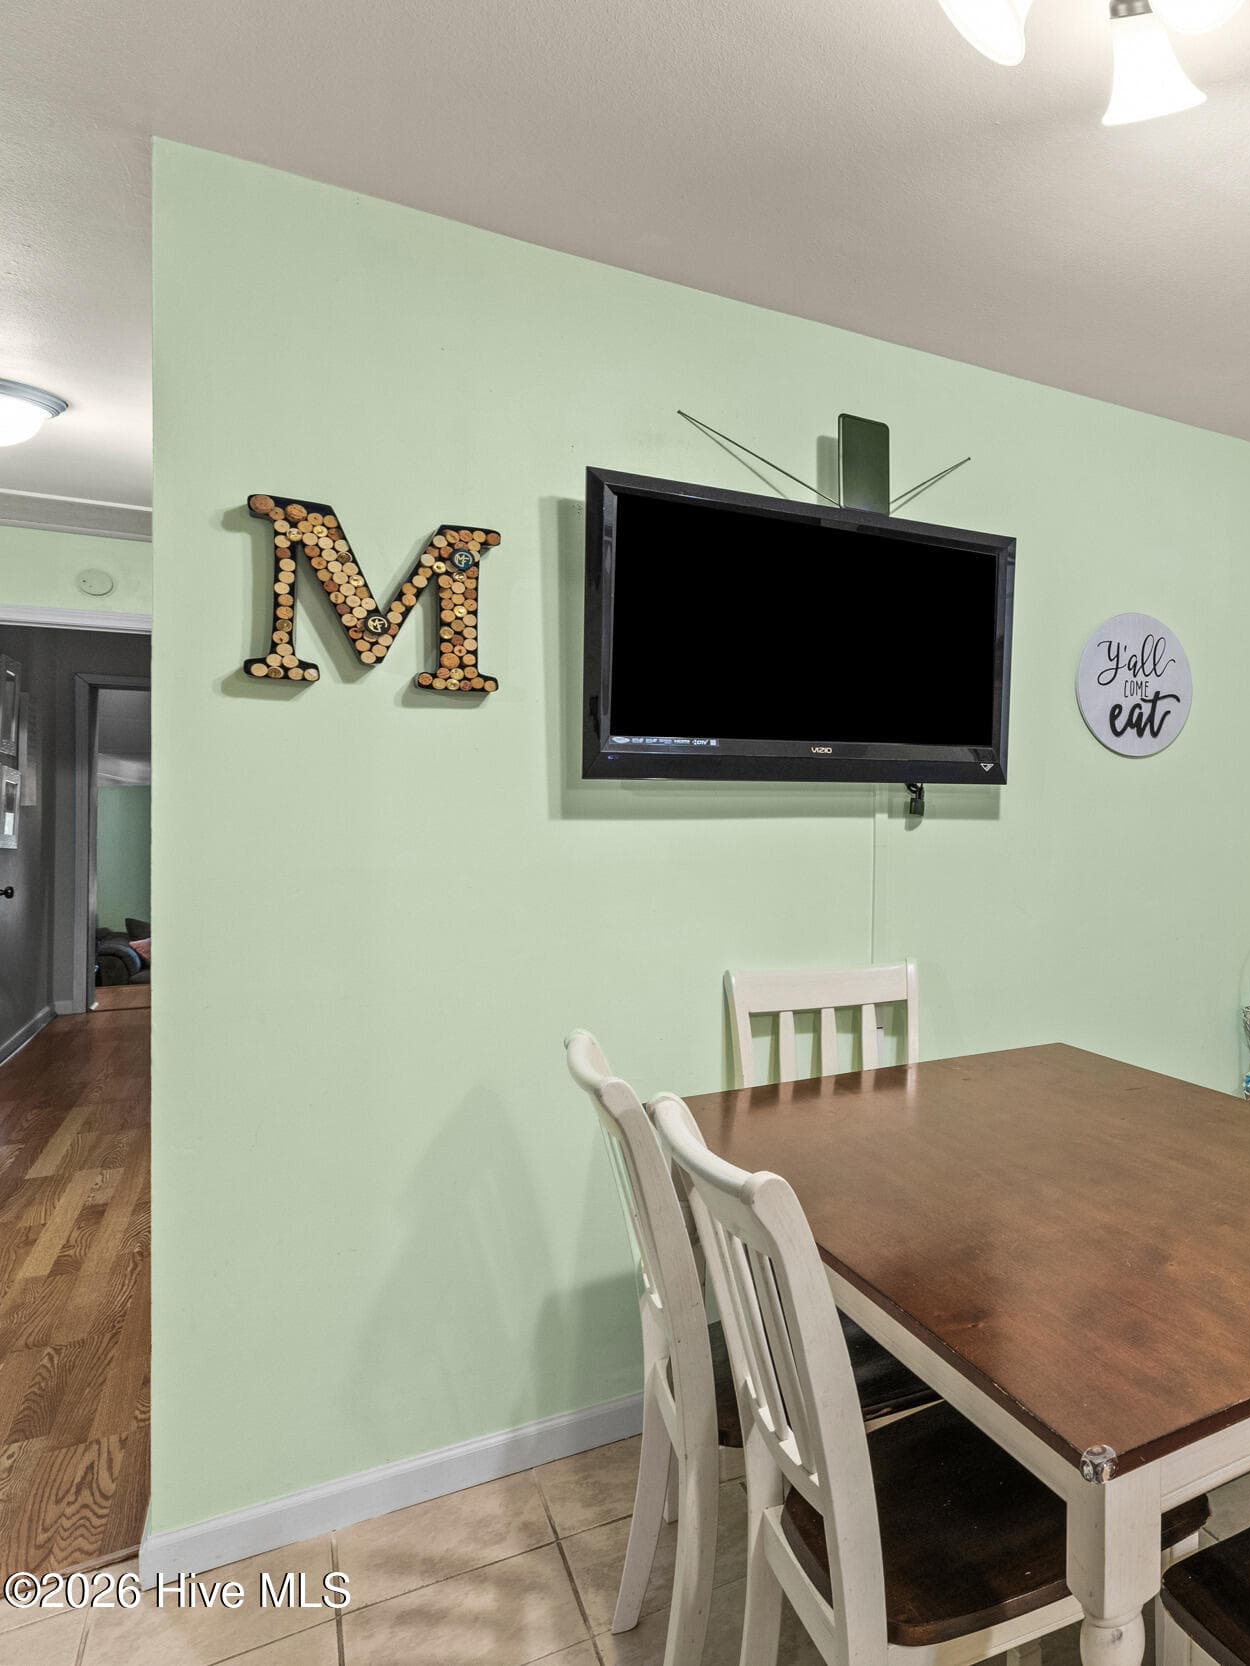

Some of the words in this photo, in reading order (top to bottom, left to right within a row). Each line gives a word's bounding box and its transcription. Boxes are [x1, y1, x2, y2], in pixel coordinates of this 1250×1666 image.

[1097, 634, 1176, 685] Y'all
[1124, 680, 1149, 698] COME
[1109, 691, 1180, 738] eat
